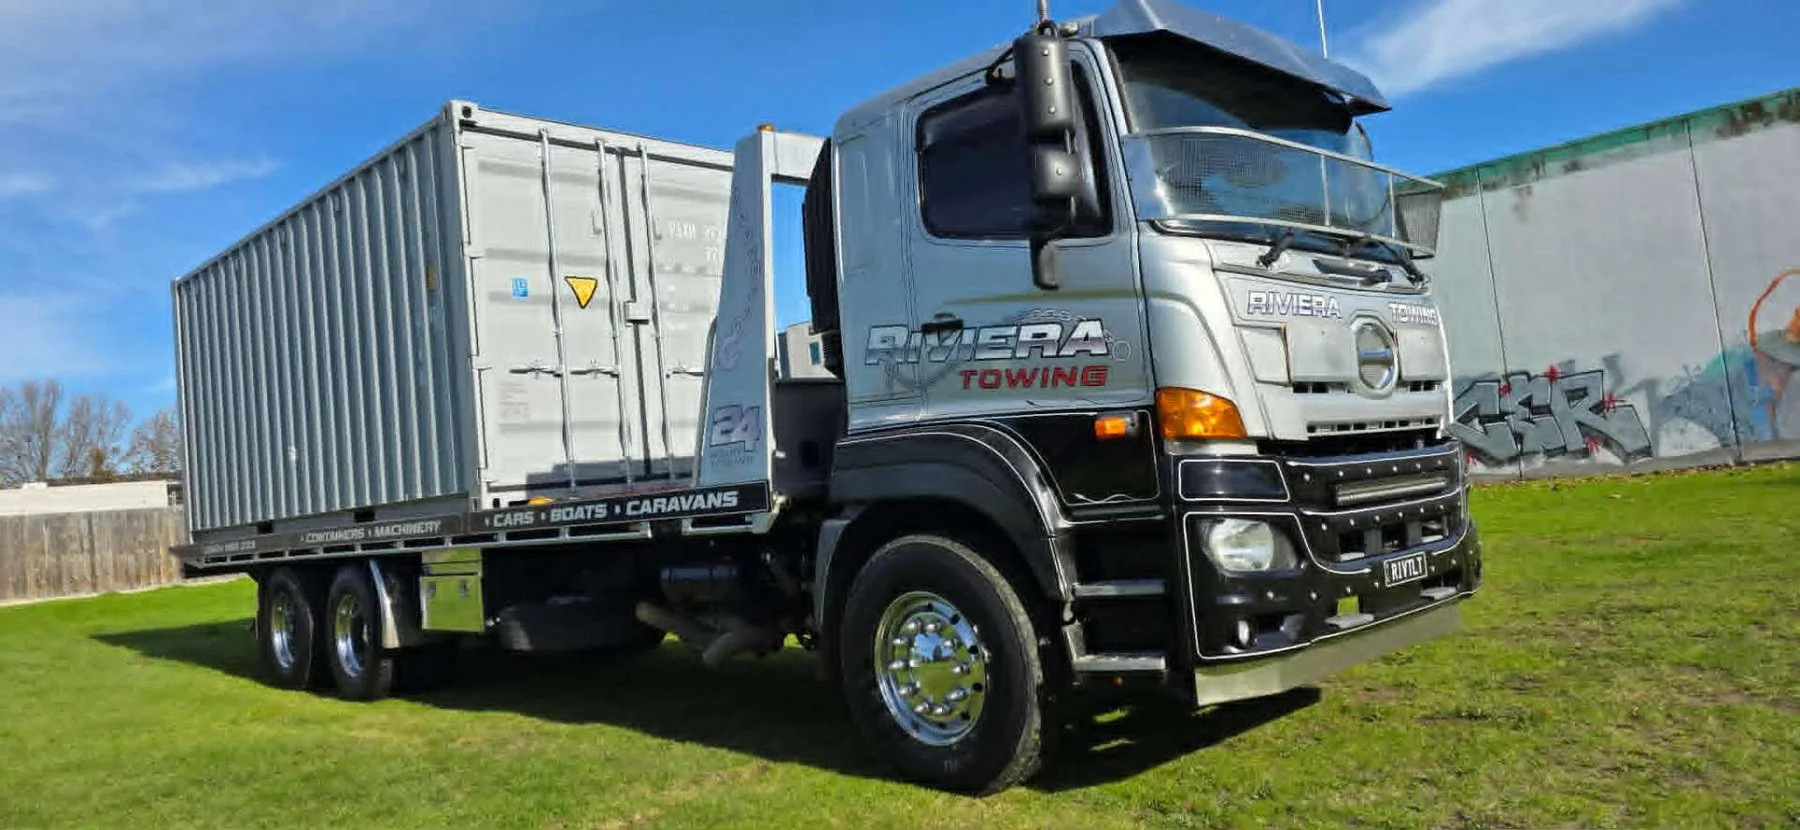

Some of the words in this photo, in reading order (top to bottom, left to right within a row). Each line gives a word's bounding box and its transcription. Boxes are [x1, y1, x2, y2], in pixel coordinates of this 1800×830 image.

[1247, 290, 1342, 318] RIVIERA
[1387, 302, 1438, 327] TOWING
[865, 317, 1109, 365] RIVIERA
[960, 365, 1111, 390] TOWING
[709, 404, 760, 453] 24
[305, 527, 366, 543] CONTAINERS
[374, 520, 442, 538] MACHINERY
[493, 510, 535, 527] CARS
[551, 503, 608, 522] BOATS
[625, 490, 739, 515] CARAVANS
[1391, 556, 1423, 581] RIVTLT
